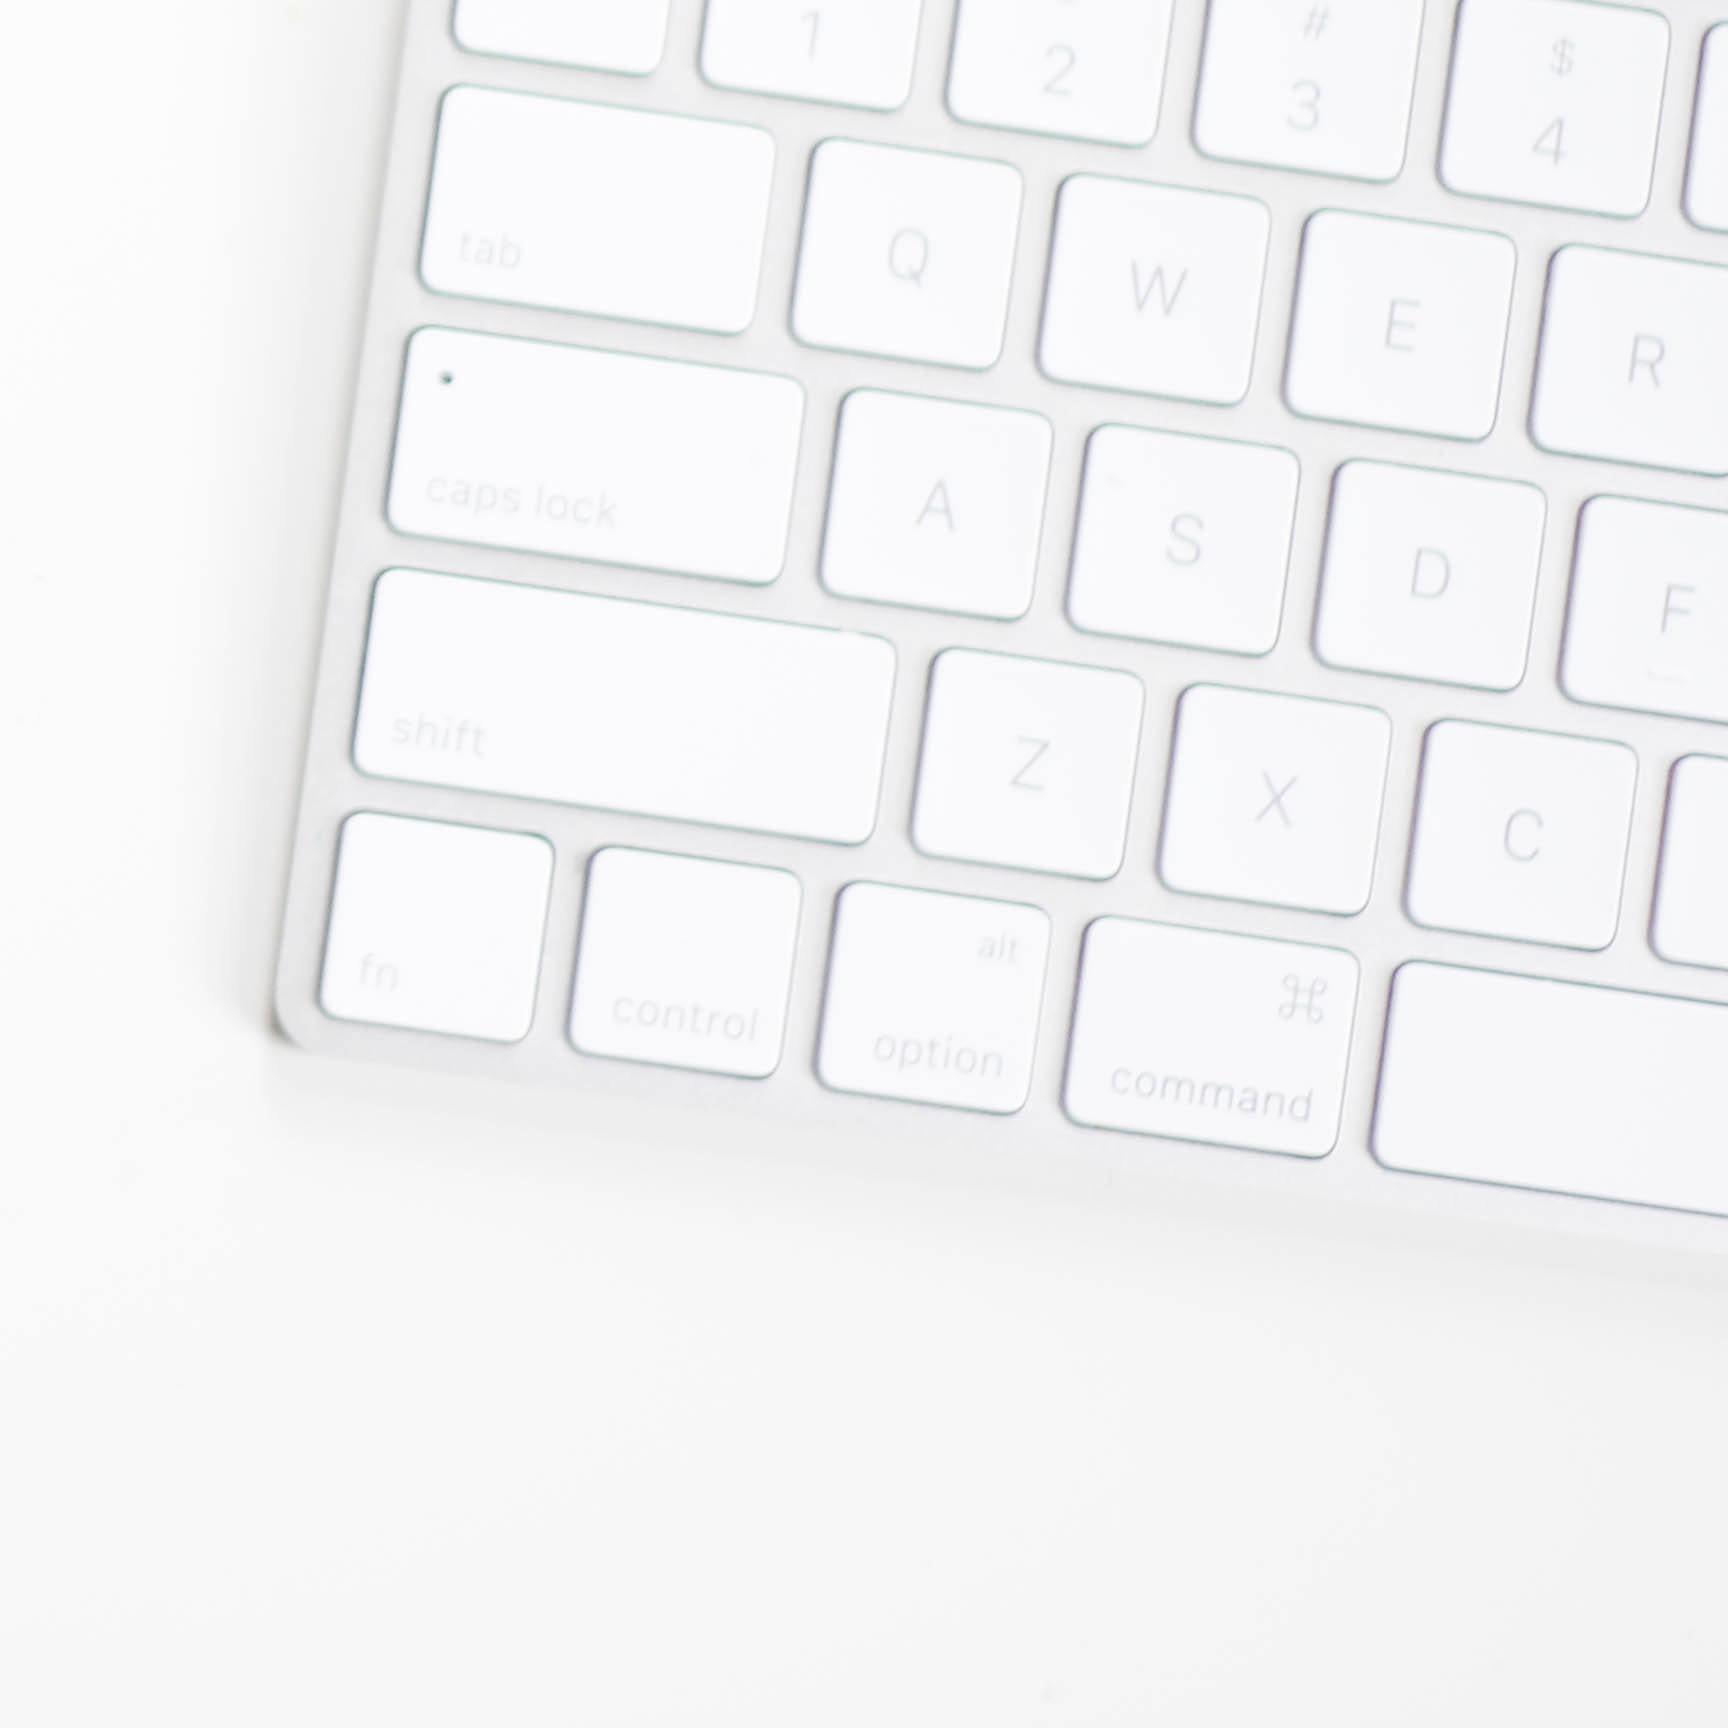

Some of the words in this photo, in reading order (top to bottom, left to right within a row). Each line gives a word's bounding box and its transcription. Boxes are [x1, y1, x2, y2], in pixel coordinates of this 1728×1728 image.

[800, 9, 820, 63] 1
[1303, 2, 1333, 41] #
[1040, 44, 1079, 97] 2
[1549, 34, 1574, 78] $
[1285, 79, 1323, 133] 3
[1531, 116, 1569, 167] 4
[456, 231, 522, 272] tab
[888, 228, 930, 288] Q
[1129, 259, 1189, 317] W
[1384, 297, 1422, 353] E
[1627, 332, 1667, 389] R
[424, 472, 522, 519] caps
[531, 483, 620, 532] lock
[914, 478, 958, 533] A
[1164, 512, 1206, 568] S
[1409, 546, 1452, 602] D
[1659, 582, 1697, 636] F
[391, 712, 488, 761] shift
[1009, 734, 1050, 792] Z
[1254, 771, 1298, 828] X
[1502, 806, 1546, 863] C
[358, 952, 400, 994] fn
[976, 929, 1022, 967] alt
[611, 991, 762, 1044] control
[872, 1028, 1006, 1082] option
[1109, 1063, 1314, 1124] command
